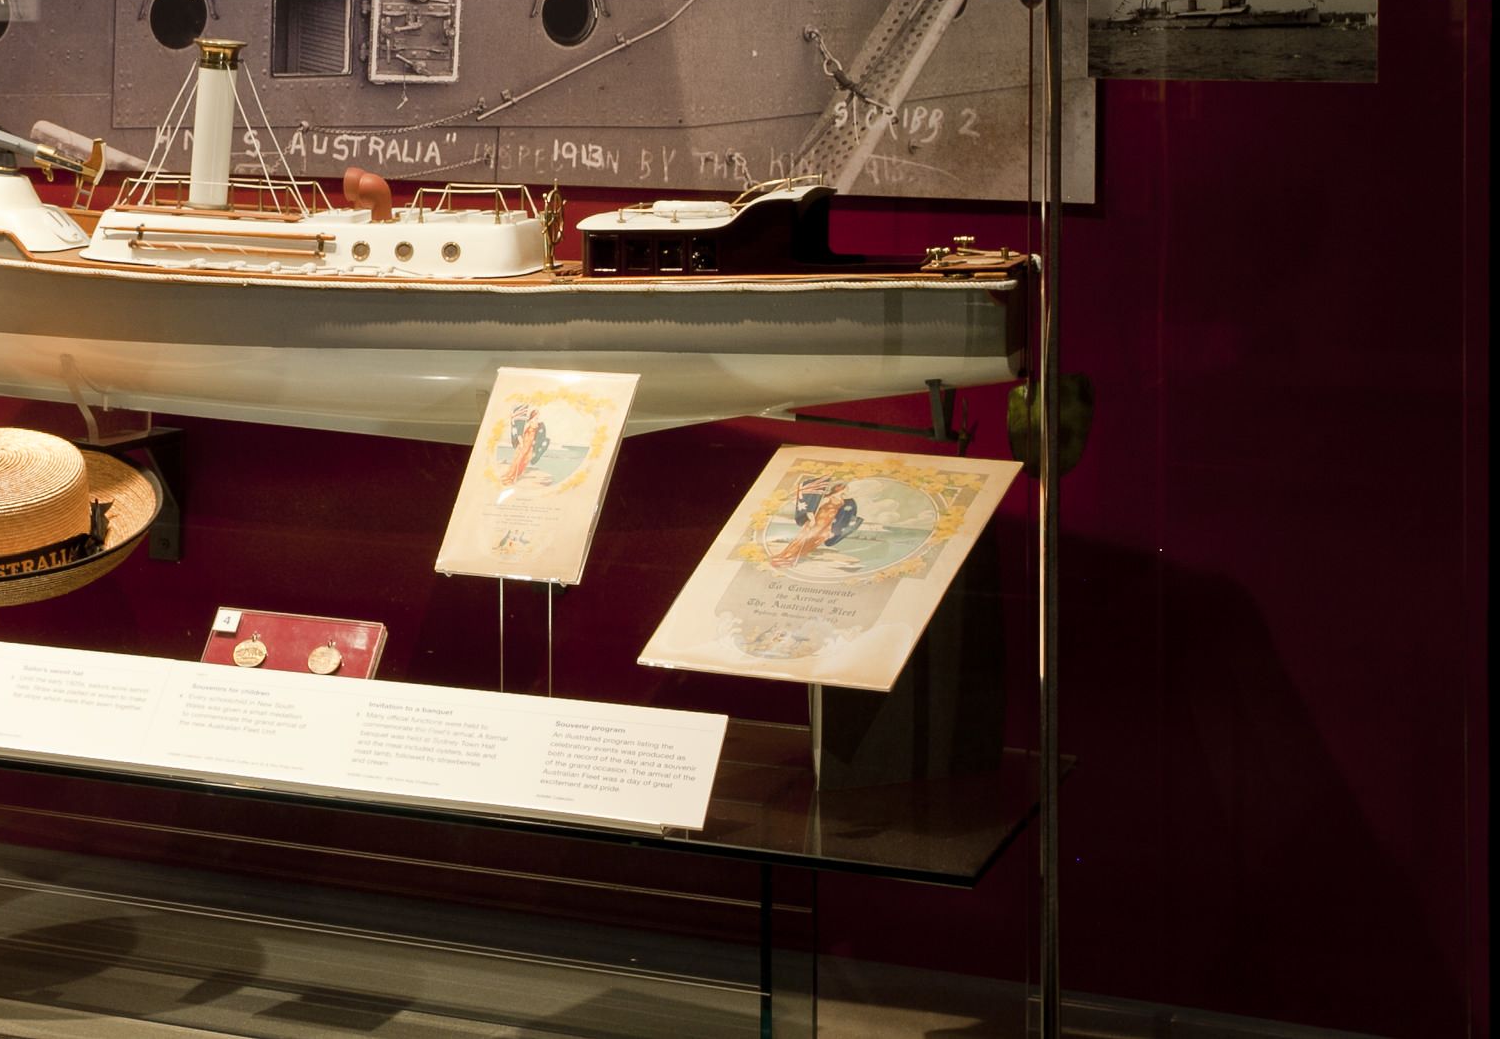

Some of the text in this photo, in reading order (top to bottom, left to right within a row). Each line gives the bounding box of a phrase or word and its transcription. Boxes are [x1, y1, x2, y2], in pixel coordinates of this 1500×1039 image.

[788, 584, 855, 597] Commemorate
[556, 721, 626, 733] Souvenir program
[565, 733, 601, 742] illustrated
[603, 738, 634, 746] program
[637, 740, 659, 750] listing
[550, 741, 591, 752] celebratory
[638, 751, 675, 759] produced
